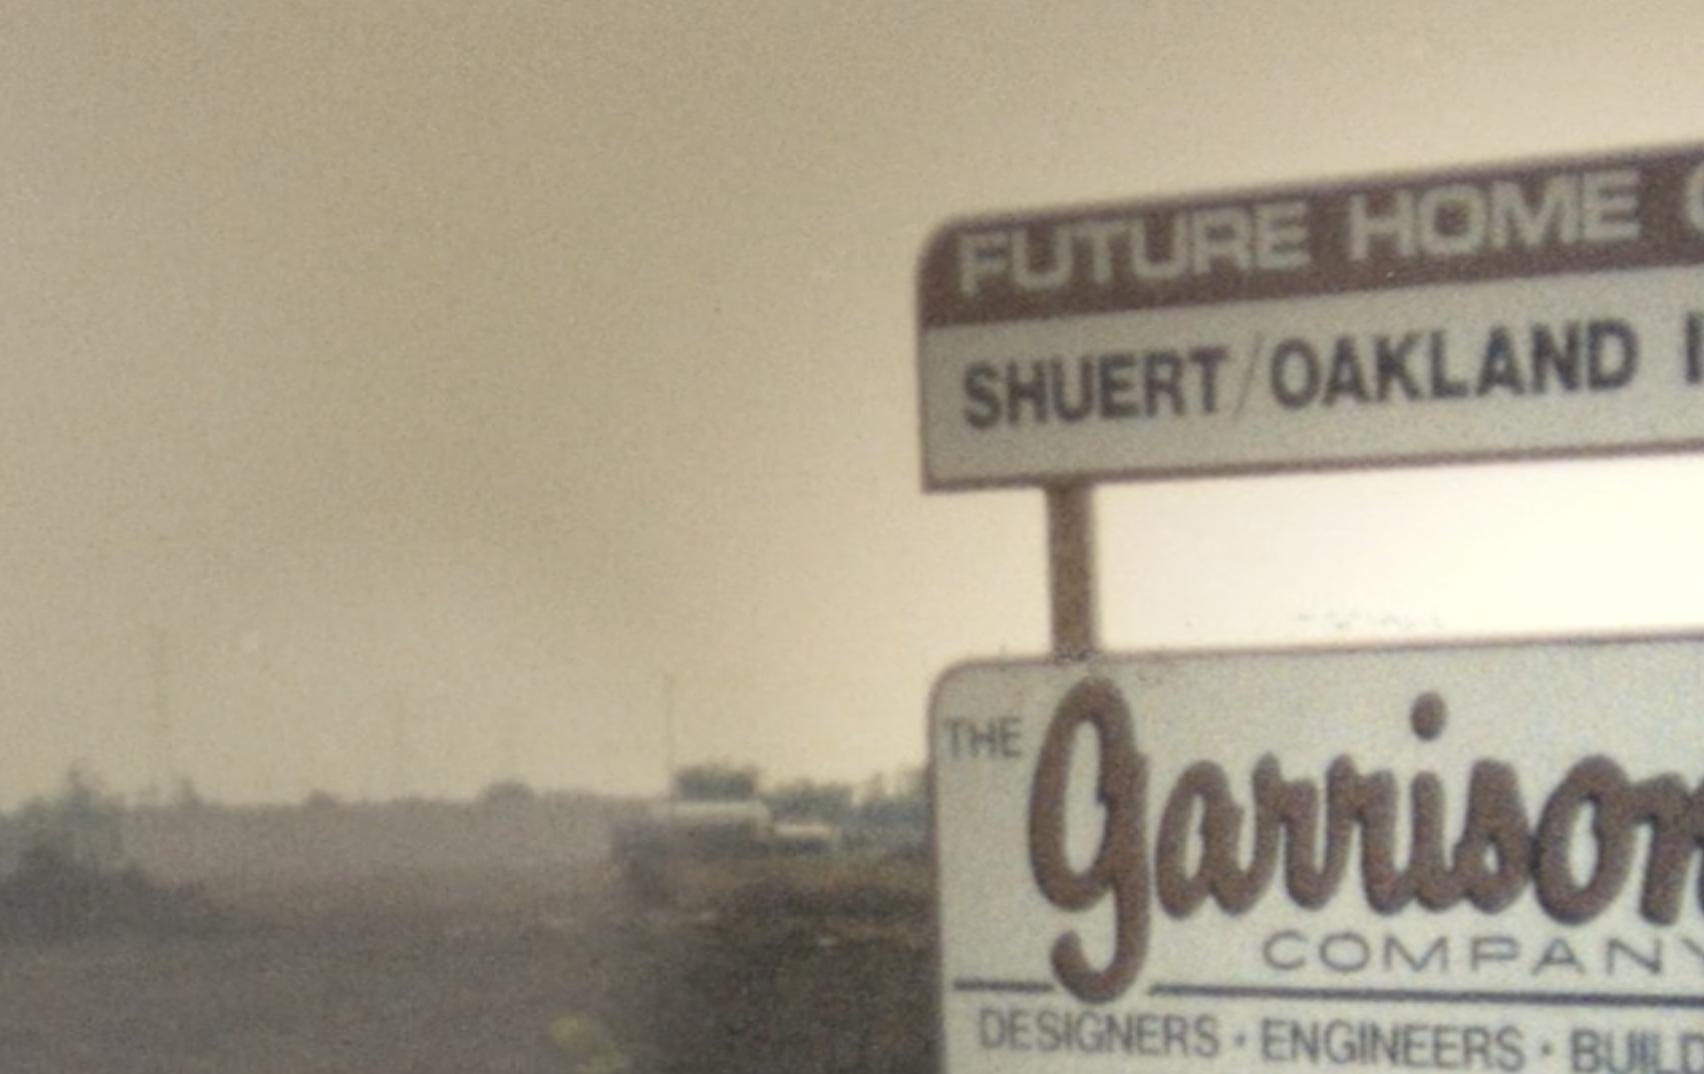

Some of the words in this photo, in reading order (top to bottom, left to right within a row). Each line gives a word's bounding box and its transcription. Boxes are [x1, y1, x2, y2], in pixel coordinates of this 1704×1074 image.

[958, 197, 1313, 297] FUTURE
[1347, 169, 1641, 262] HOME
[946, 717, 1024, 759] THE
[980, 1012, 1220, 1058] DESIGNERS
[1263, 1018, 1524, 1069] ENGINEERS
